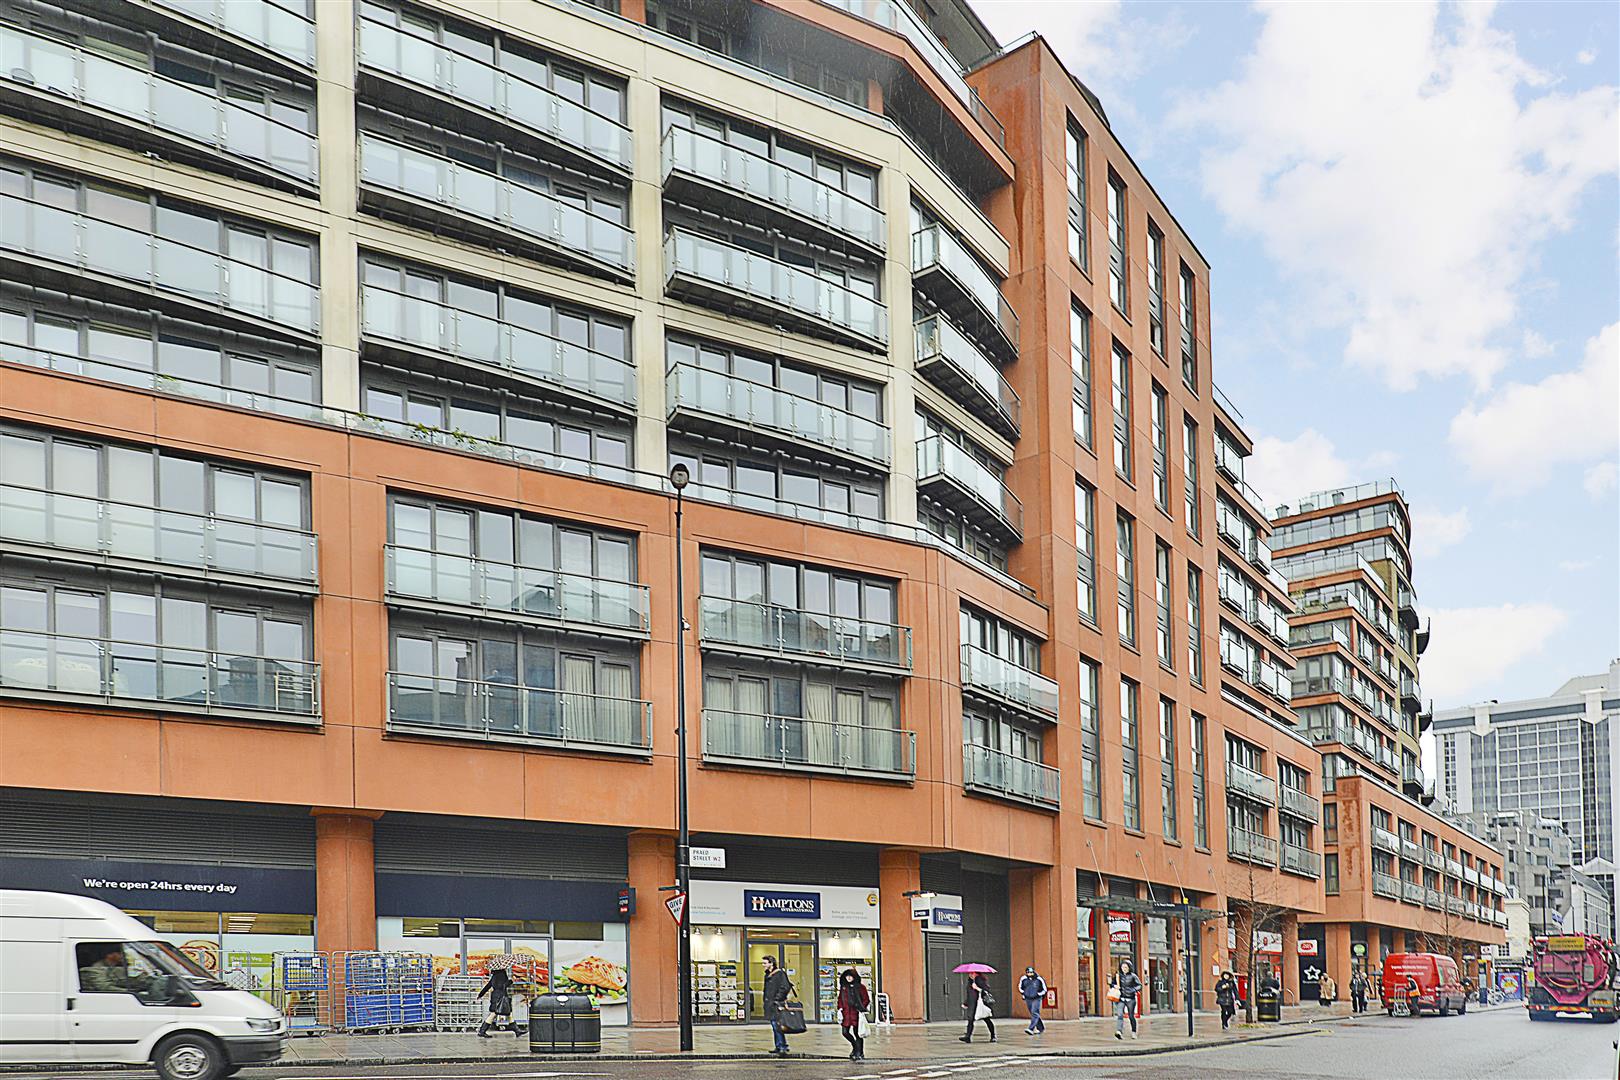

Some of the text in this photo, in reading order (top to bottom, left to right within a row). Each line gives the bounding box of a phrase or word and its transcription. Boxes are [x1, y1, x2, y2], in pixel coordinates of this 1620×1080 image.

[83, 878, 237, 894] We're open 24hrs every day
[669, 898, 683, 909] GIVE
[751, 896, 815, 912] HAMPTONS
